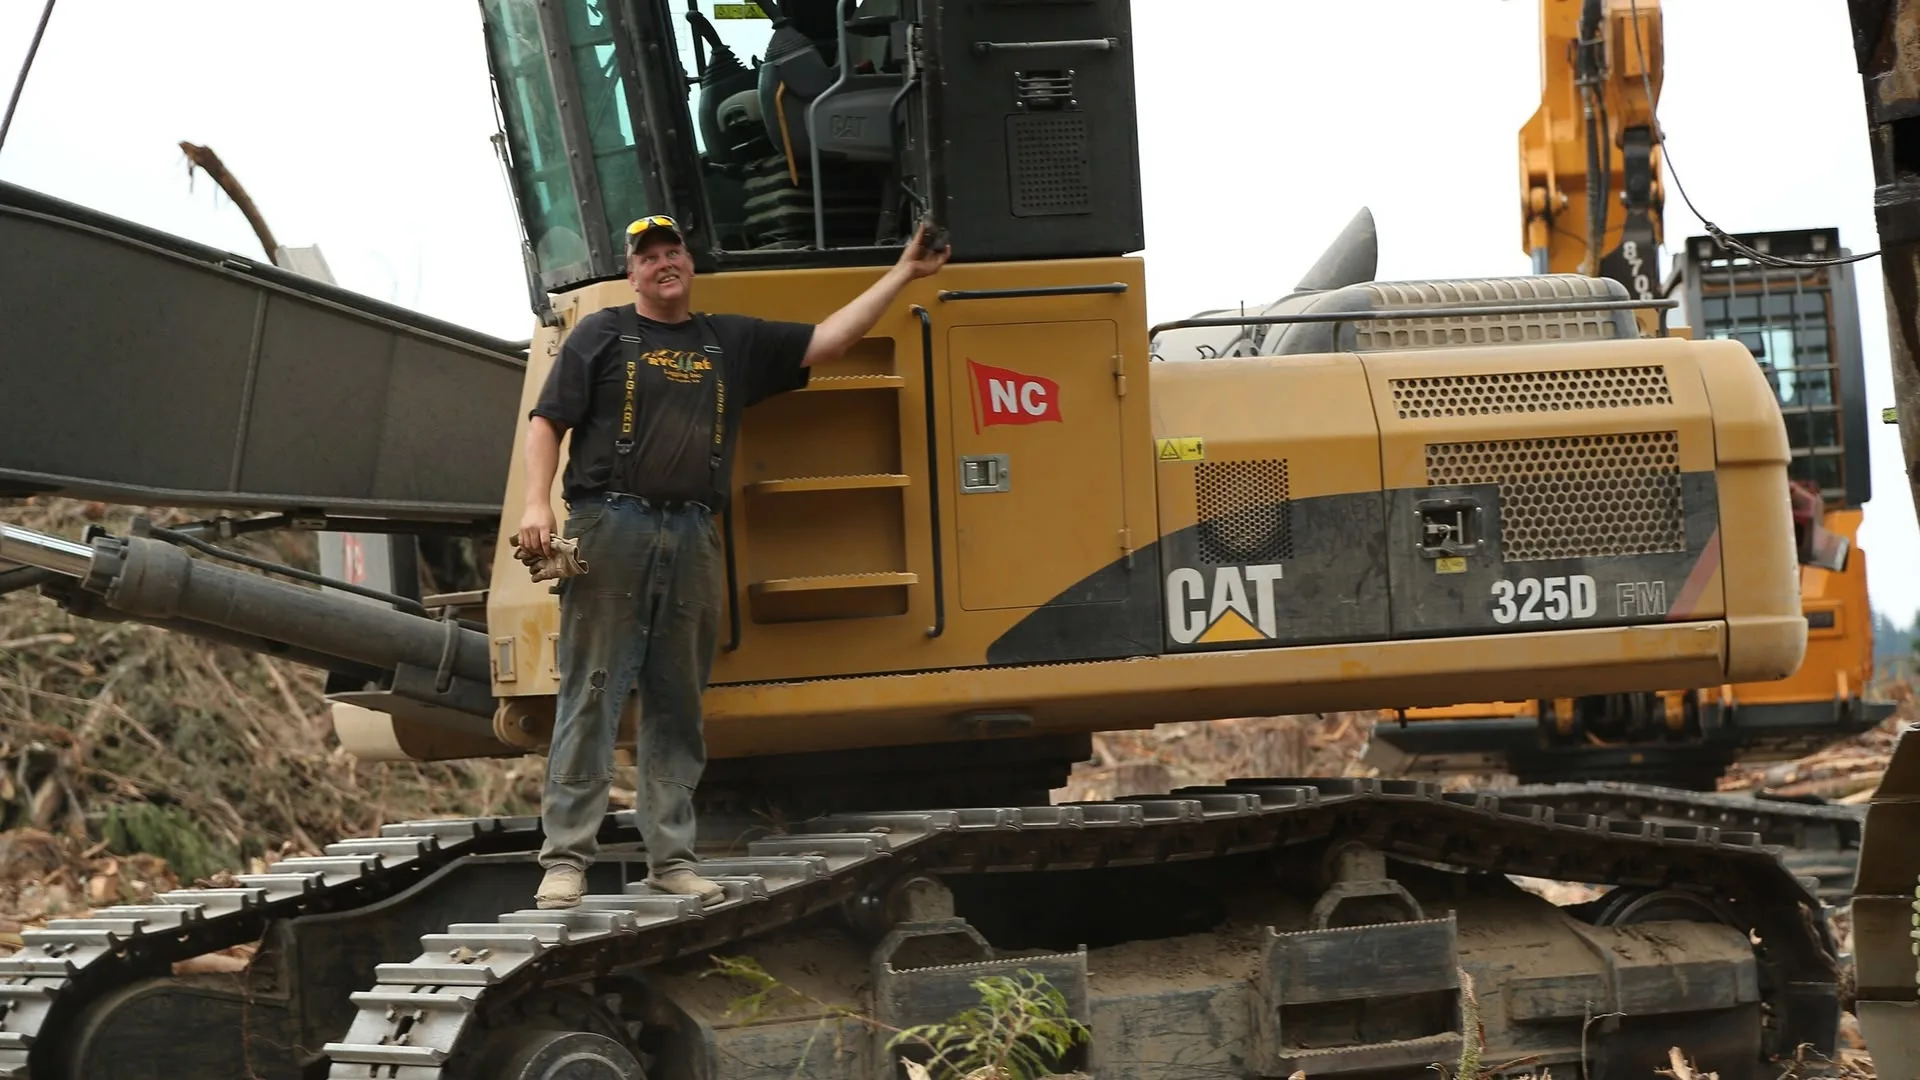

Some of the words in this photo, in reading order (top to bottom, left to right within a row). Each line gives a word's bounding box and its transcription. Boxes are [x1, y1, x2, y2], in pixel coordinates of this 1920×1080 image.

[831, 114, 868, 139] CAT
[622, 361, 636, 433] RYGAARD
[989, 379, 1047, 415] NC
[1167, 564, 1283, 643] CAT
[1491, 575, 1597, 624] 325D
[1616, 580, 1667, 618] FM
